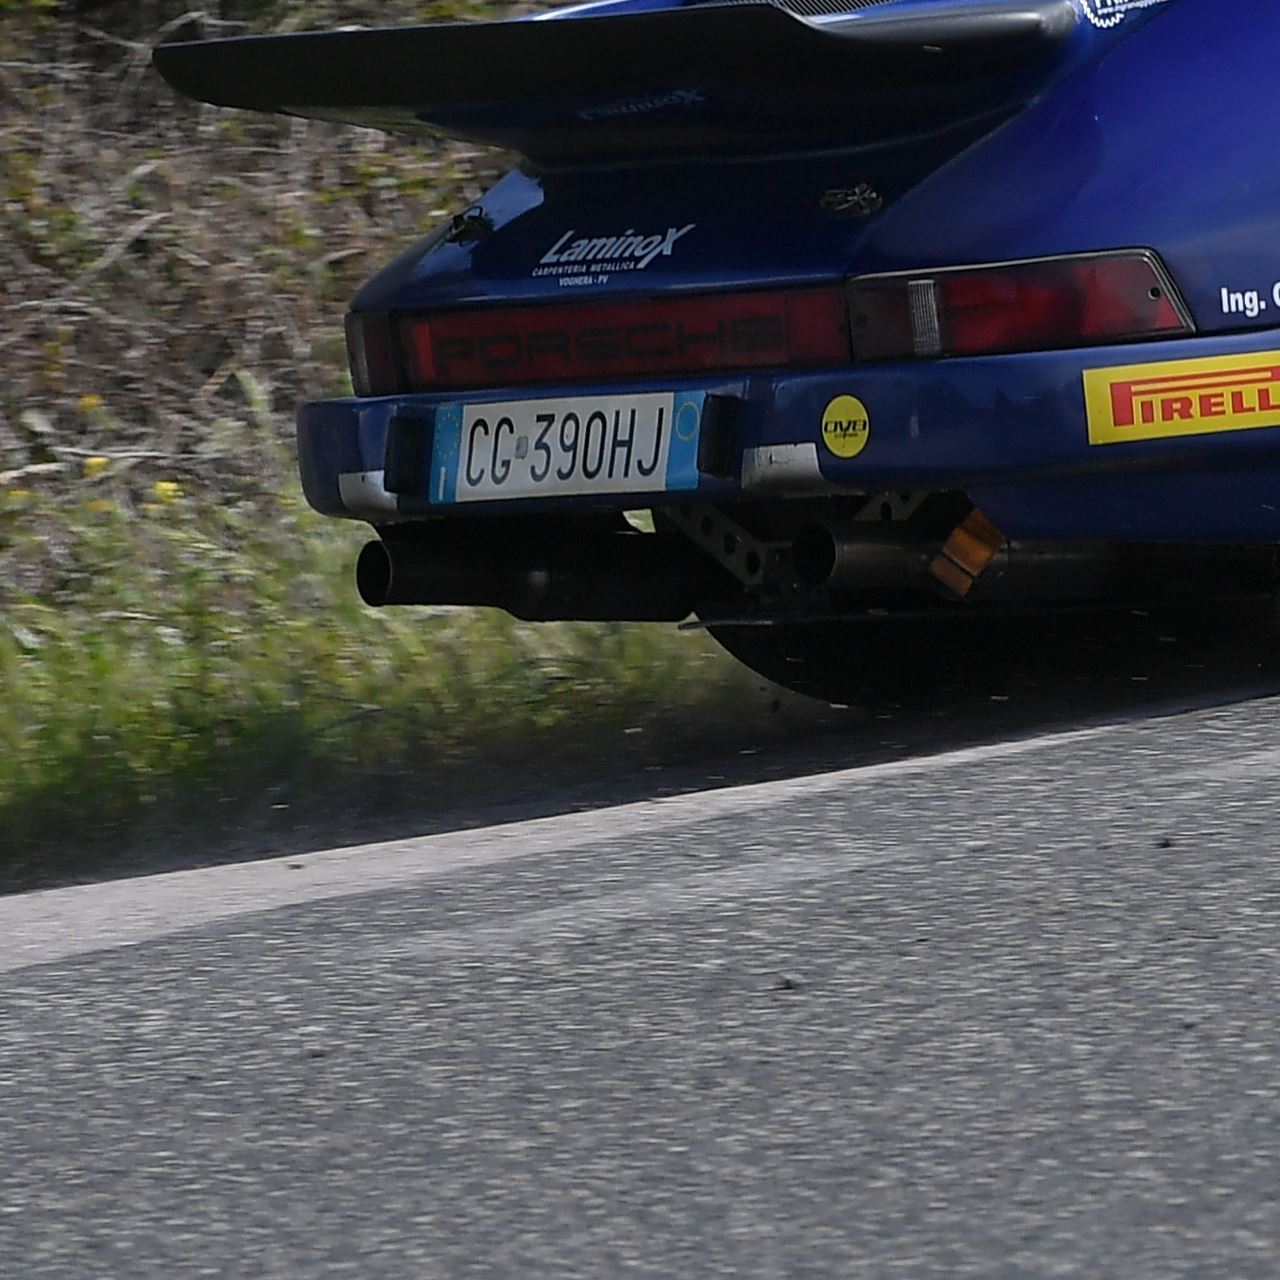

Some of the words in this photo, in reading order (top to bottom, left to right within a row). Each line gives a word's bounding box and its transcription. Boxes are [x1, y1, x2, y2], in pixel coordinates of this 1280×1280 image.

[532, 267, 587, 277] CARPENTERIA
[590, 261, 635, 272] METALLICA
[559, 277, 593, 287] VOGHERA
[1220, 287, 1266, 318] Ing.
[432, 315, 784, 378] PORSCHE
